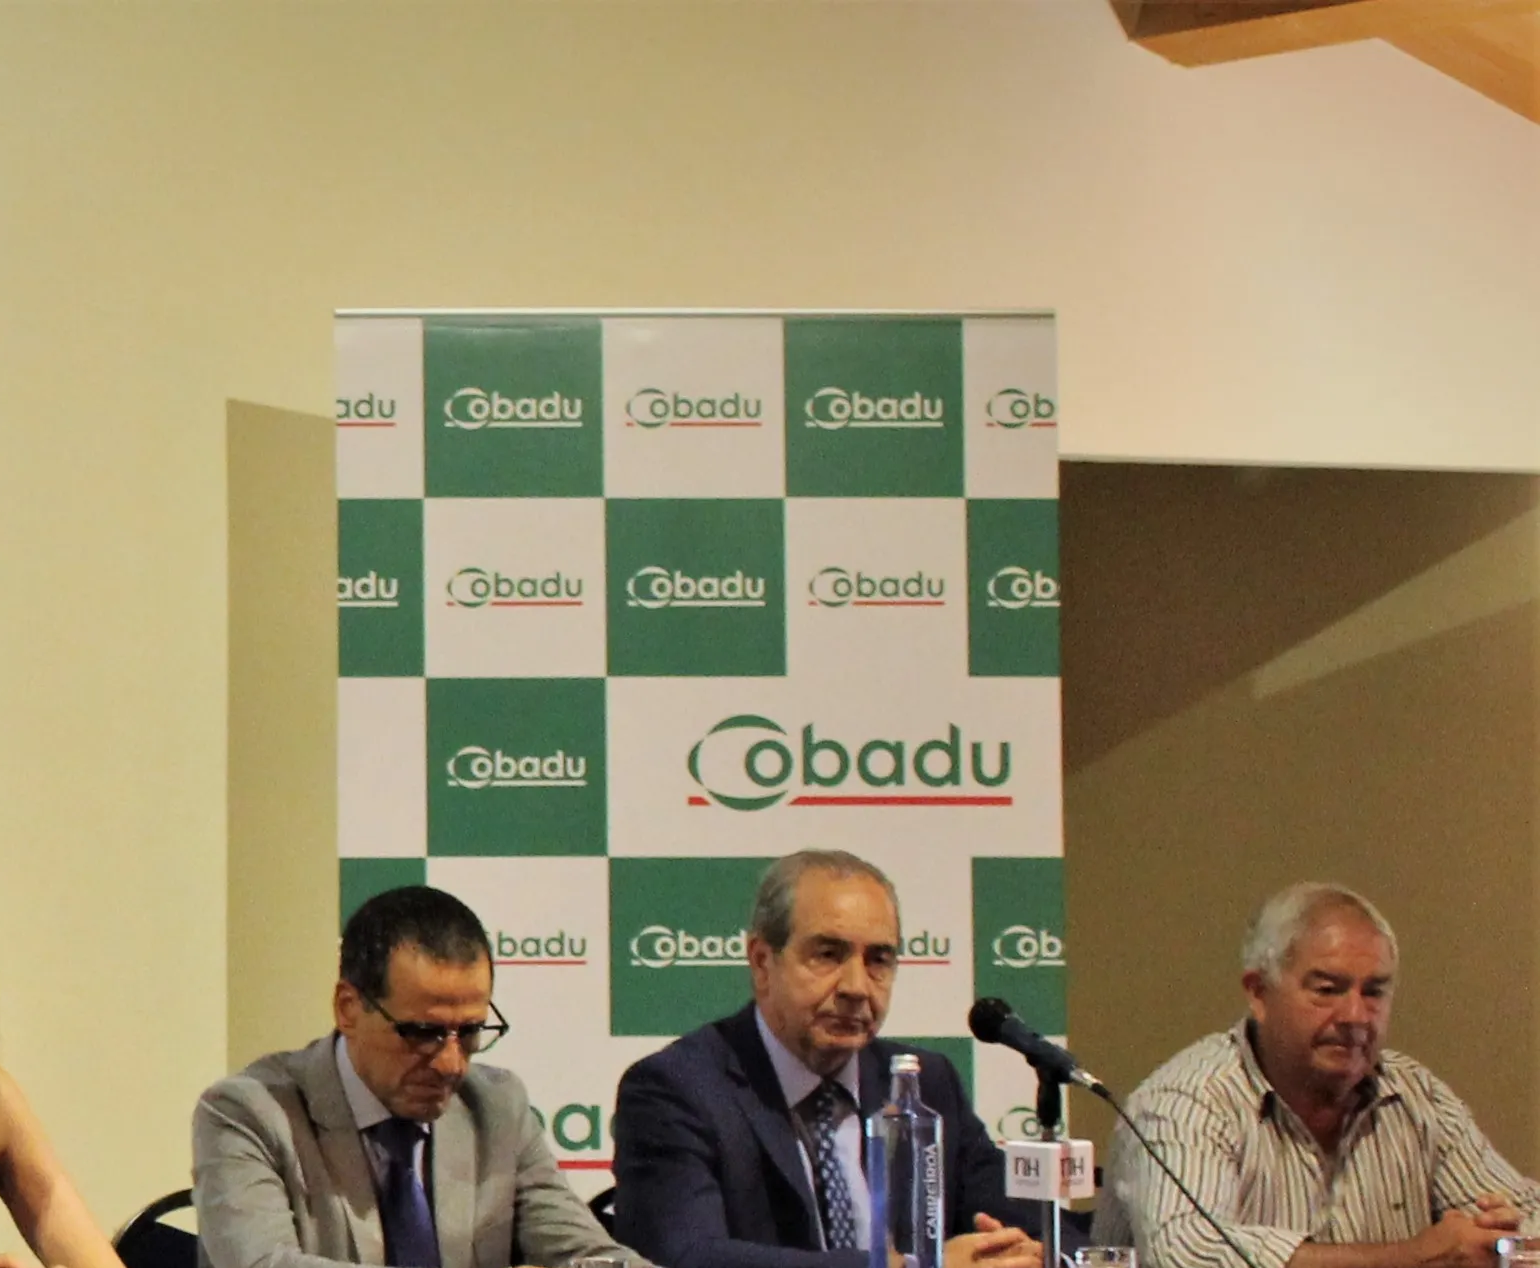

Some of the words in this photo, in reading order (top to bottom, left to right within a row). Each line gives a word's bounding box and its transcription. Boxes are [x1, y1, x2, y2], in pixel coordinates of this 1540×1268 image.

[444, 387, 582, 429] Cobadu
[626, 388, 762, 428] Cobadu
[805, 387, 944, 430] Cobadu
[447, 567, 582, 607] Cobadu
[627, 566, 766, 608] Cobadu
[809, 567, 944, 607] Cobadu
[447, 746, 587, 789] Cobadu
[687, 714, 1013, 811] Cobadu
[495, 930, 587, 957] badu
[630, 925, 748, 968] Cobad
